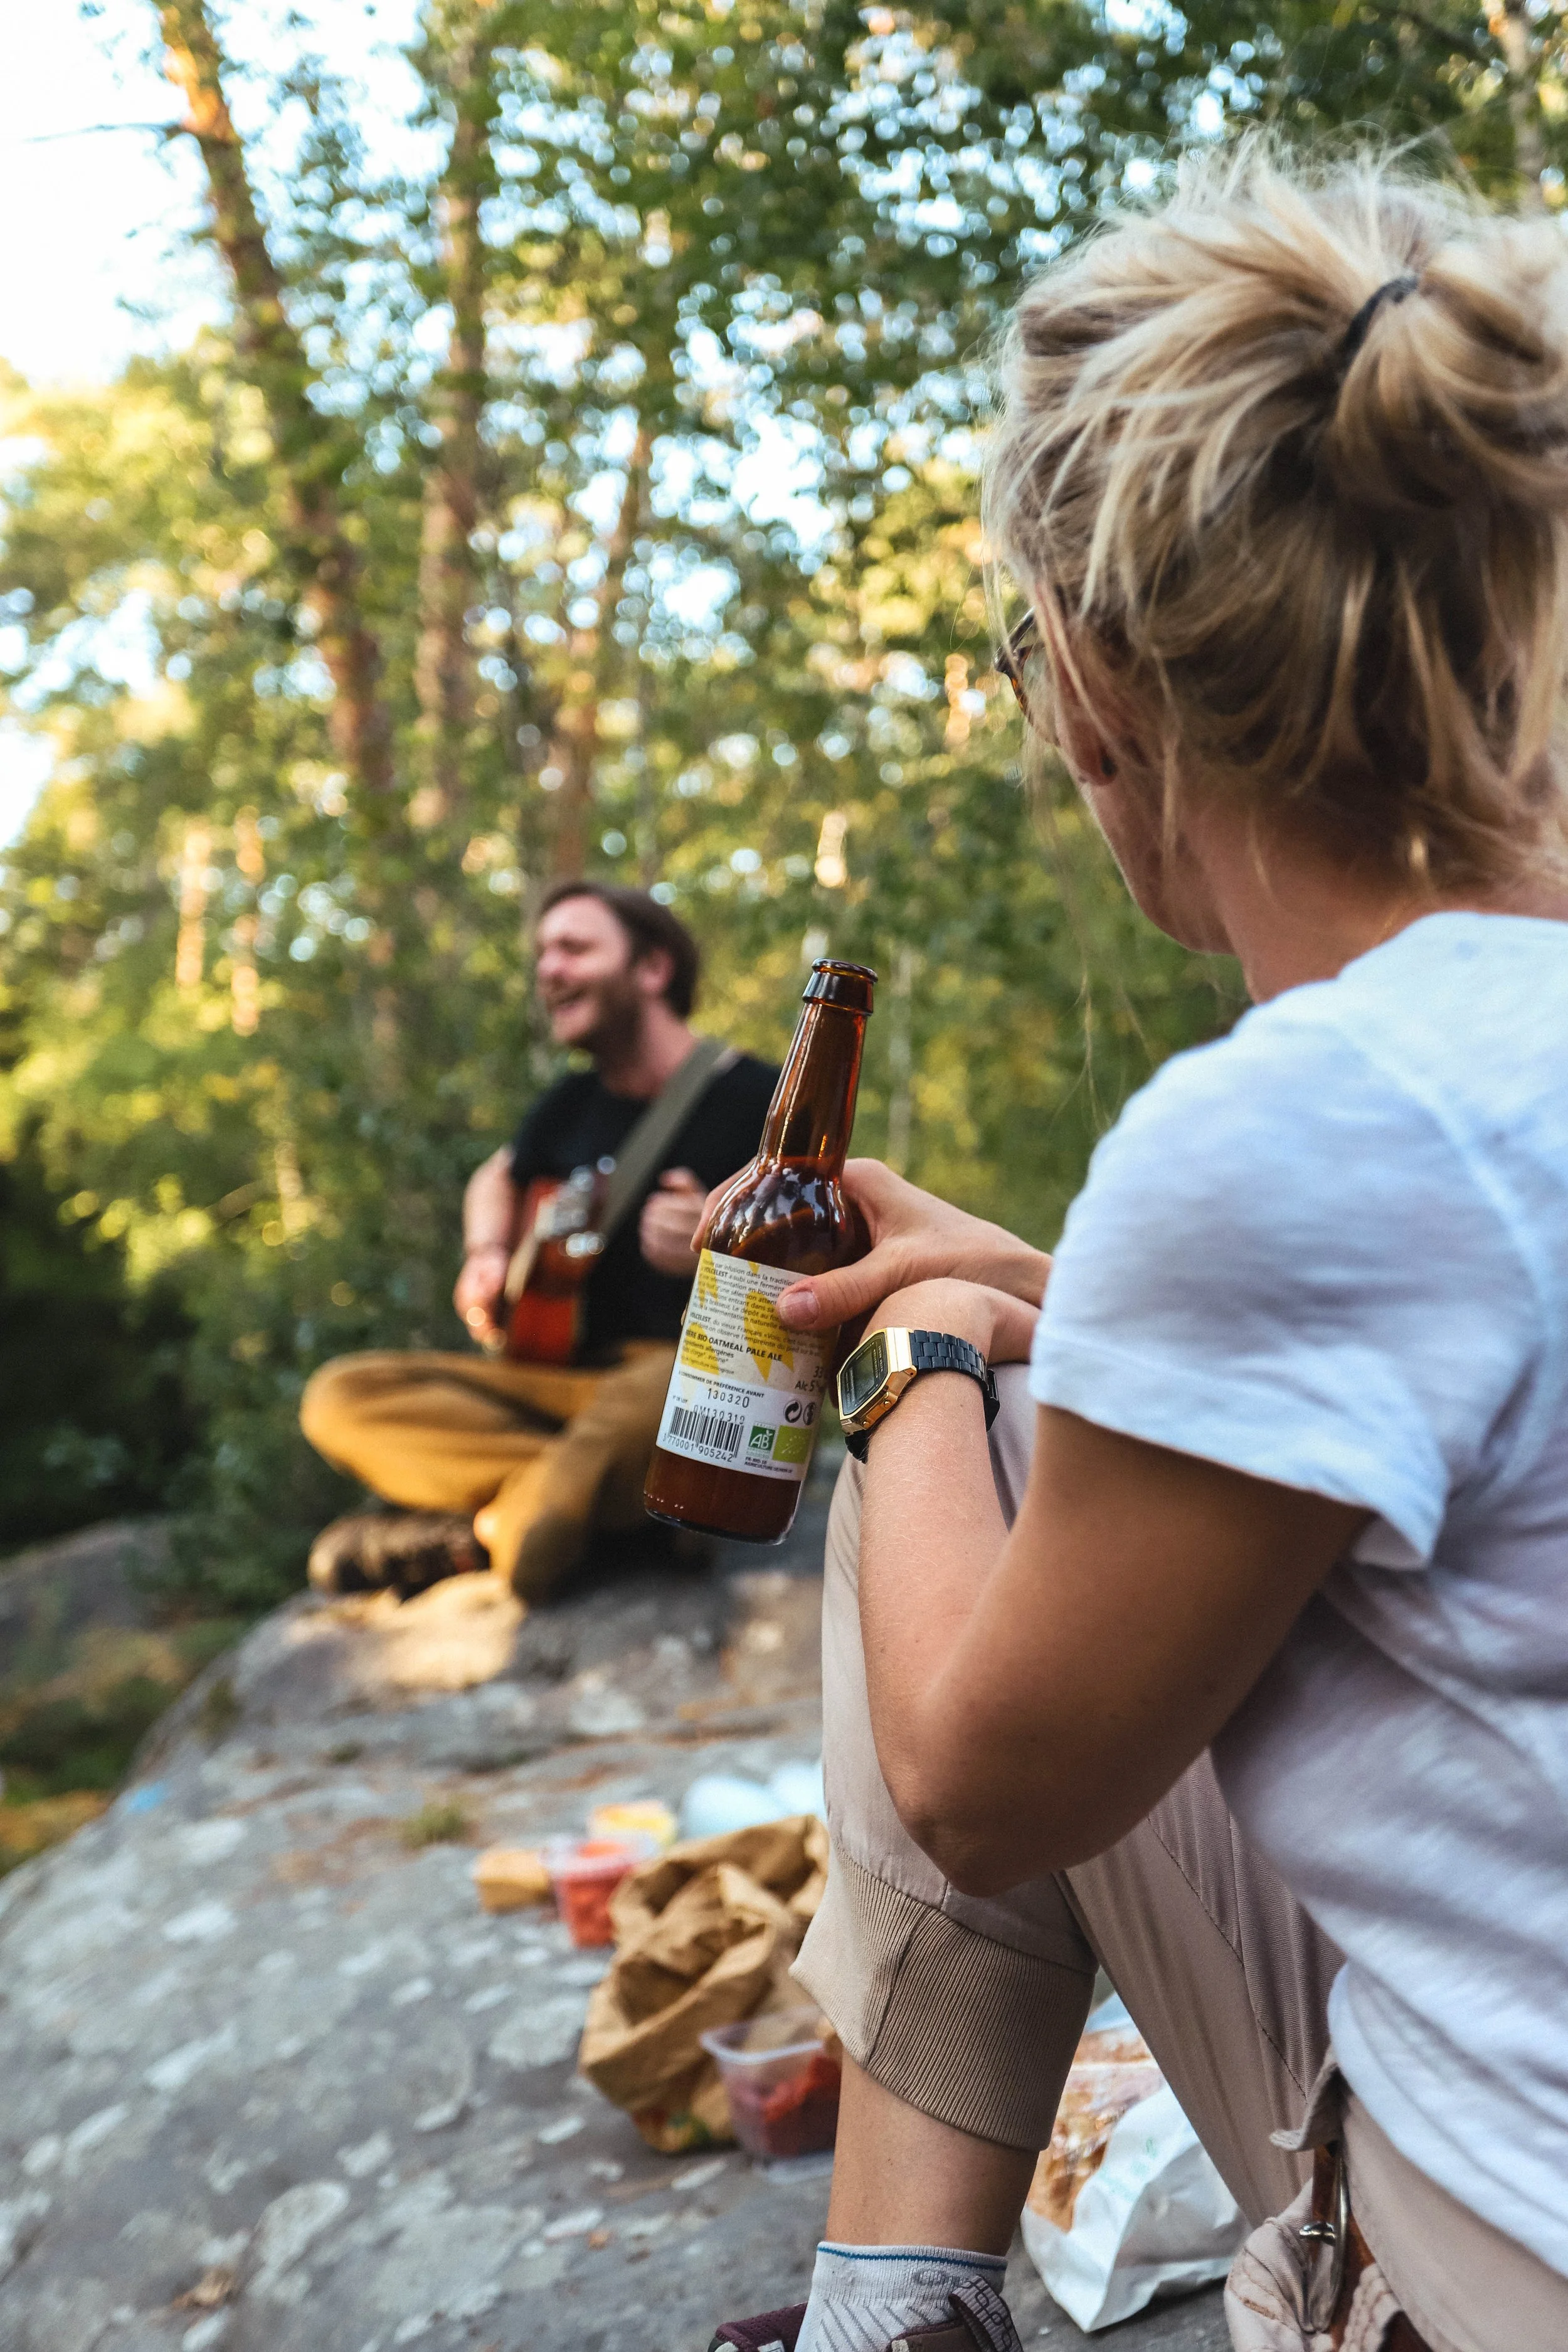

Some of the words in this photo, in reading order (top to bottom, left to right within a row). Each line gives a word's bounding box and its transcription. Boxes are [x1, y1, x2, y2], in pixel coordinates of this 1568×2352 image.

[723, 1265, 745, 1273] infusion
[746, 1271, 760, 1279] dans
[711, 1277, 746, 1290] ermentation
[758, 1288, 780, 1298] bouteil
[760, 1281, 784, 1291] ferment
[728, 1297, 749, 1306] entrant
[731, 1290, 756, 1300] sélection
[758, 1297, 776, 1305] attent
[741, 1308, 759, 1316] dépôt
[750, 1318, 778, 1328] naturelle
[717, 1328, 739, 1338] observe
[741, 1335, 776, 1347] l'empreinte
[737, 1326, 762, 1337] Français
[697, 1333, 707, 1342] BIO
[709, 1337, 743, 1352] OATMEAL
[746, 1347, 766, 1358] PALE
[767, 1352, 783, 1362] ALE
[713, 1381, 744, 1393] PRÉFÉRENCE
[746, 1390, 765, 1398] AVANT
[795, 1380, 808, 1391] Alc
[707, 1388, 750, 1408] 130320
[750, 1434, 770, 1449] AB
[668, 1436, 694, 1452] 770001
[698, 1446, 733, 1463] 905242
